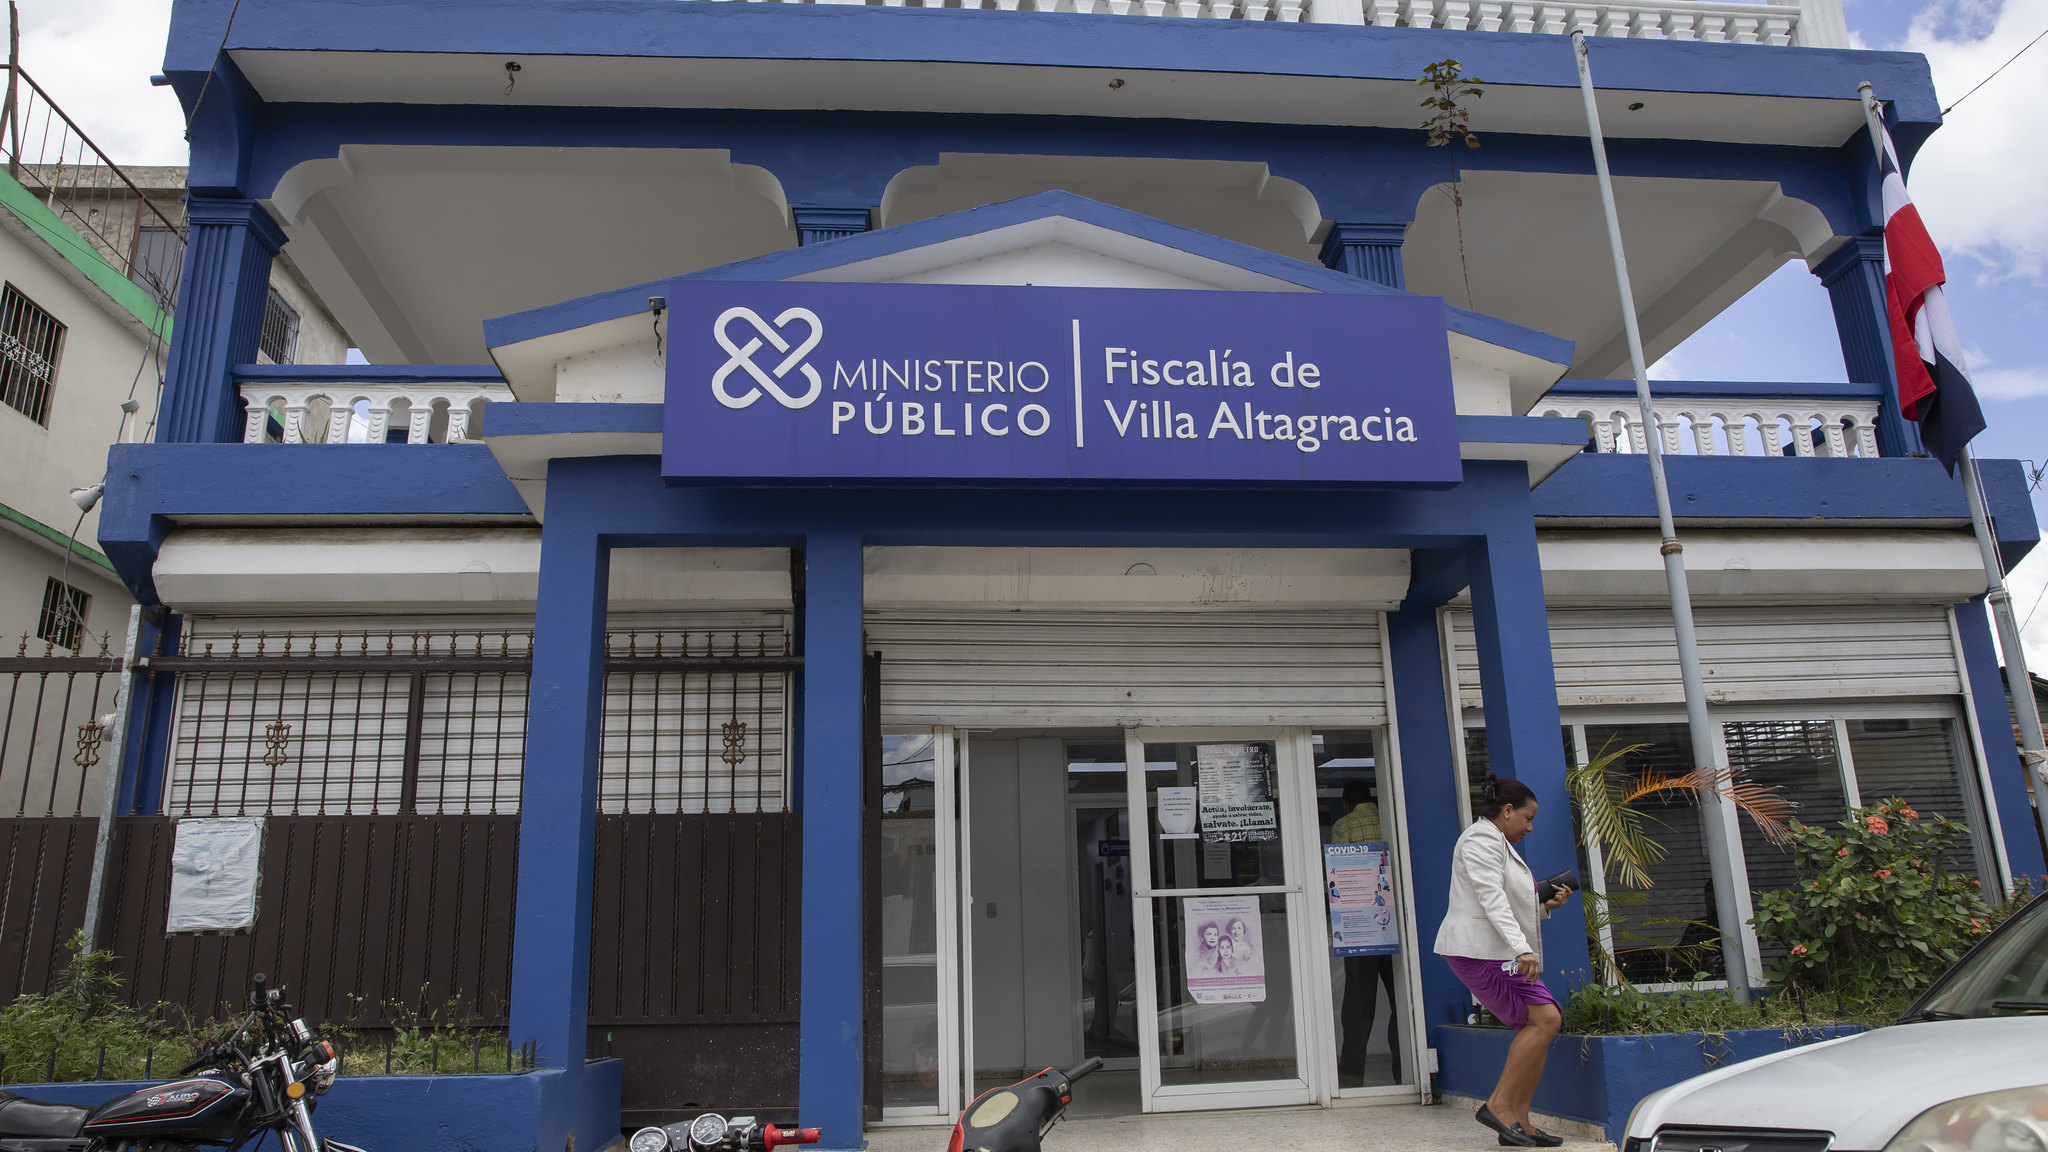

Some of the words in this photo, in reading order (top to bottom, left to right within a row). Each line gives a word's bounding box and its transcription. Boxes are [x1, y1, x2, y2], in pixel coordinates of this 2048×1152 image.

[832, 358, 1050, 393] MINISTERIO
[1104, 346, 1256, 388] Fiscalía
[1270, 350, 1322, 391] de
[831, 391, 1051, 438] PÚBLICO
[1103, 399, 1200, 440] Villa
[1207, 400, 1420, 454] Altagracia
[1202, 806, 1227, 814] Actúa,
[1228, 804, 1272, 812] involúcrate,
[1203, 820, 1239, 829] sálvate.
[1239, 818, 1274, 828] ¡Llama!
[1327, 845, 1369, 855] COVID-19
[157, 1091, 200, 1105] TAURO
